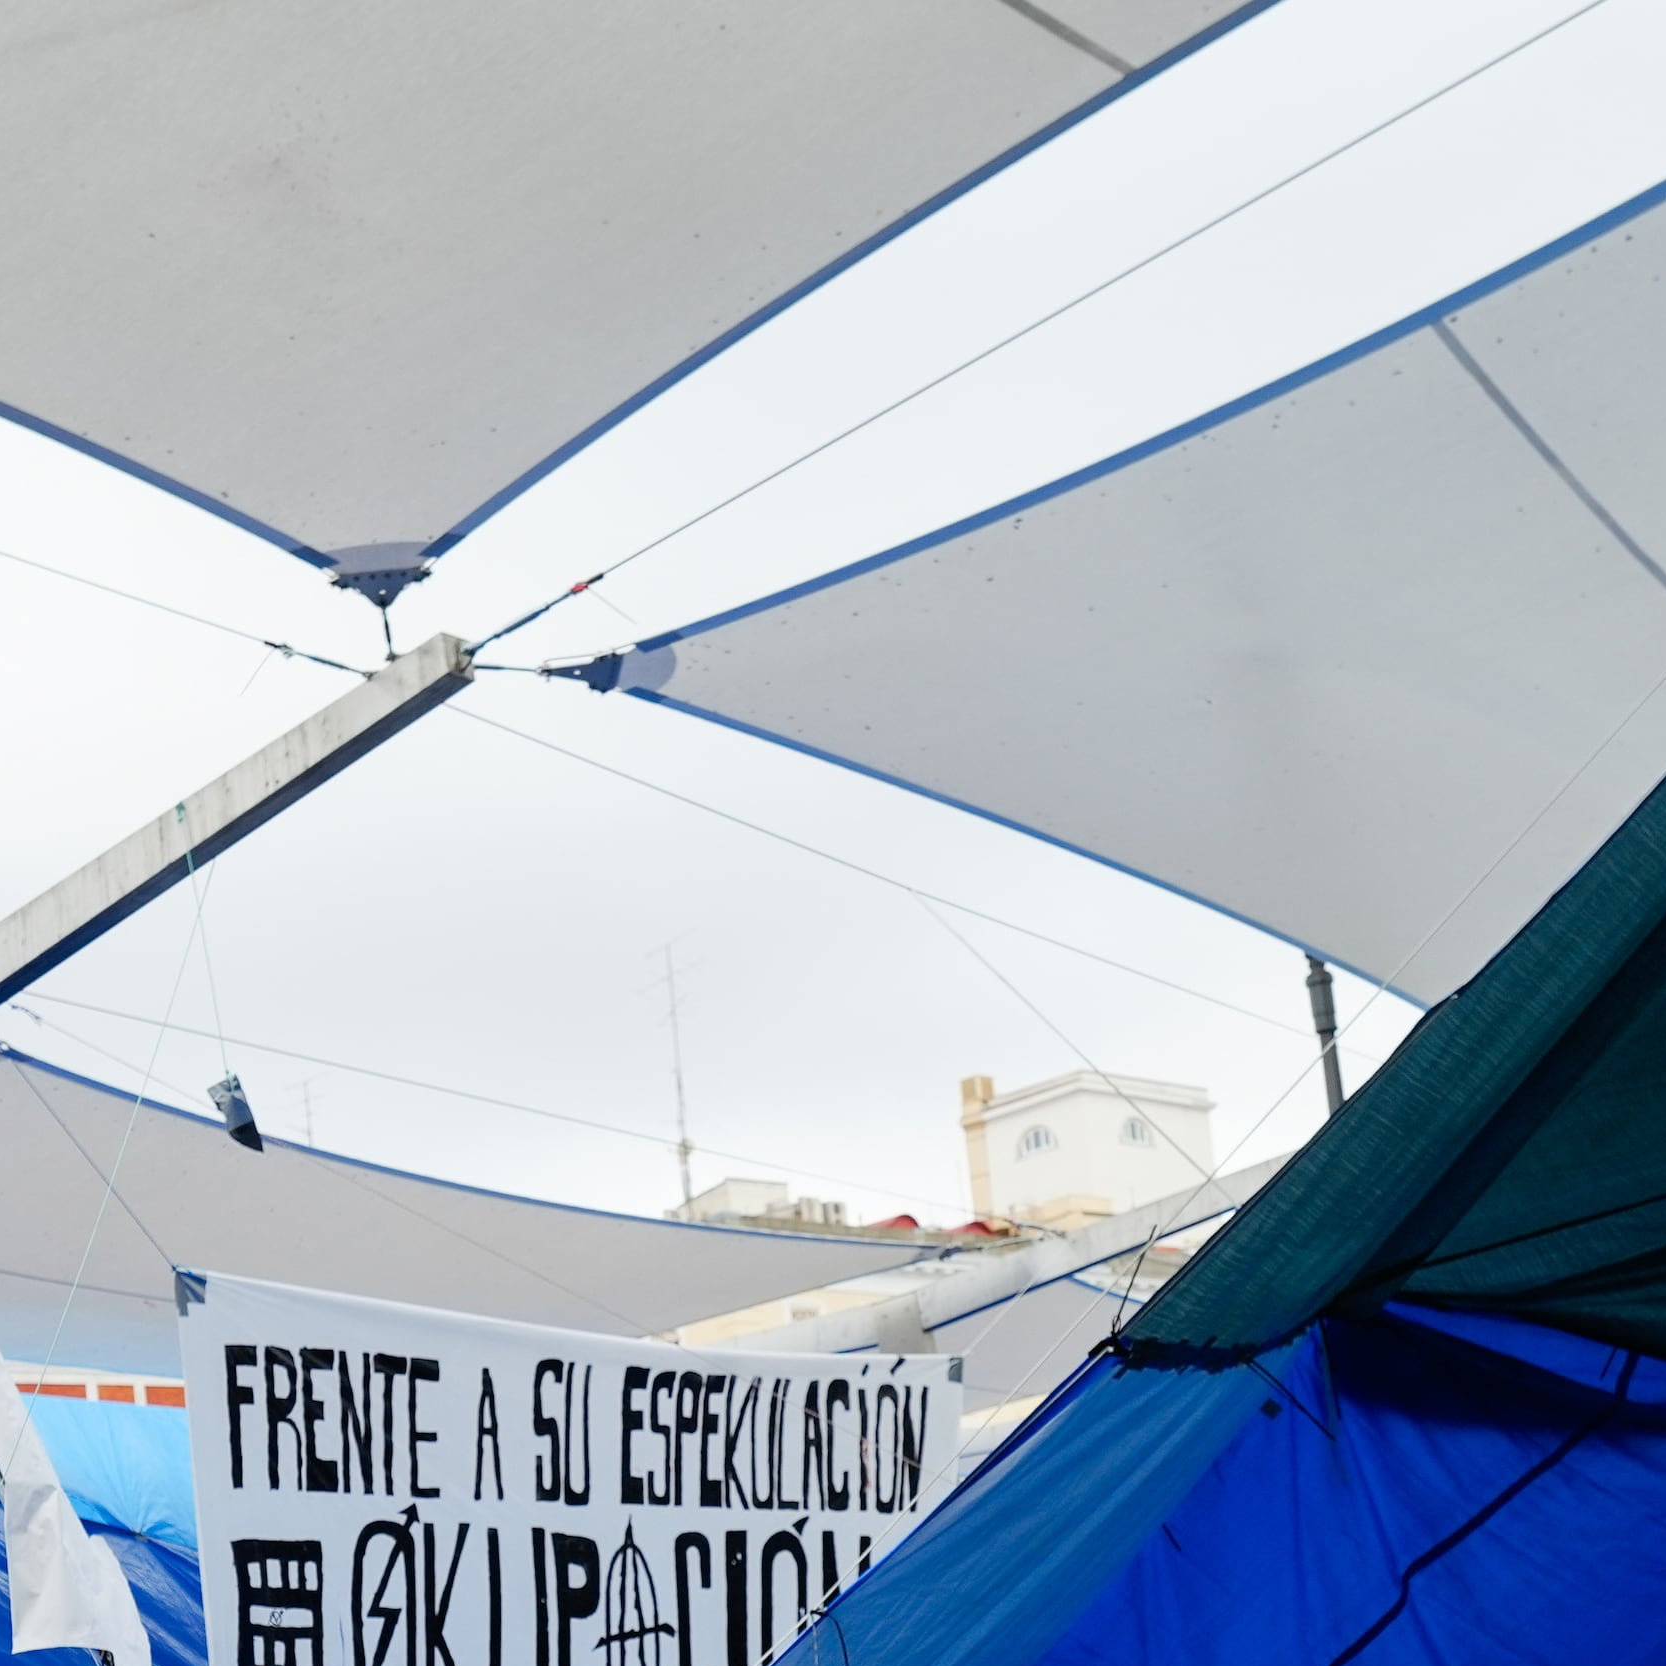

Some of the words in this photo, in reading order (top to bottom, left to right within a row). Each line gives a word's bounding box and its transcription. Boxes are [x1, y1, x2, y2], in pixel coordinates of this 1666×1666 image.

[224, 1344, 441, 1500] FRENTE
[474, 1367, 504, 1501] A
[534, 1358, 593, 1506] SU
